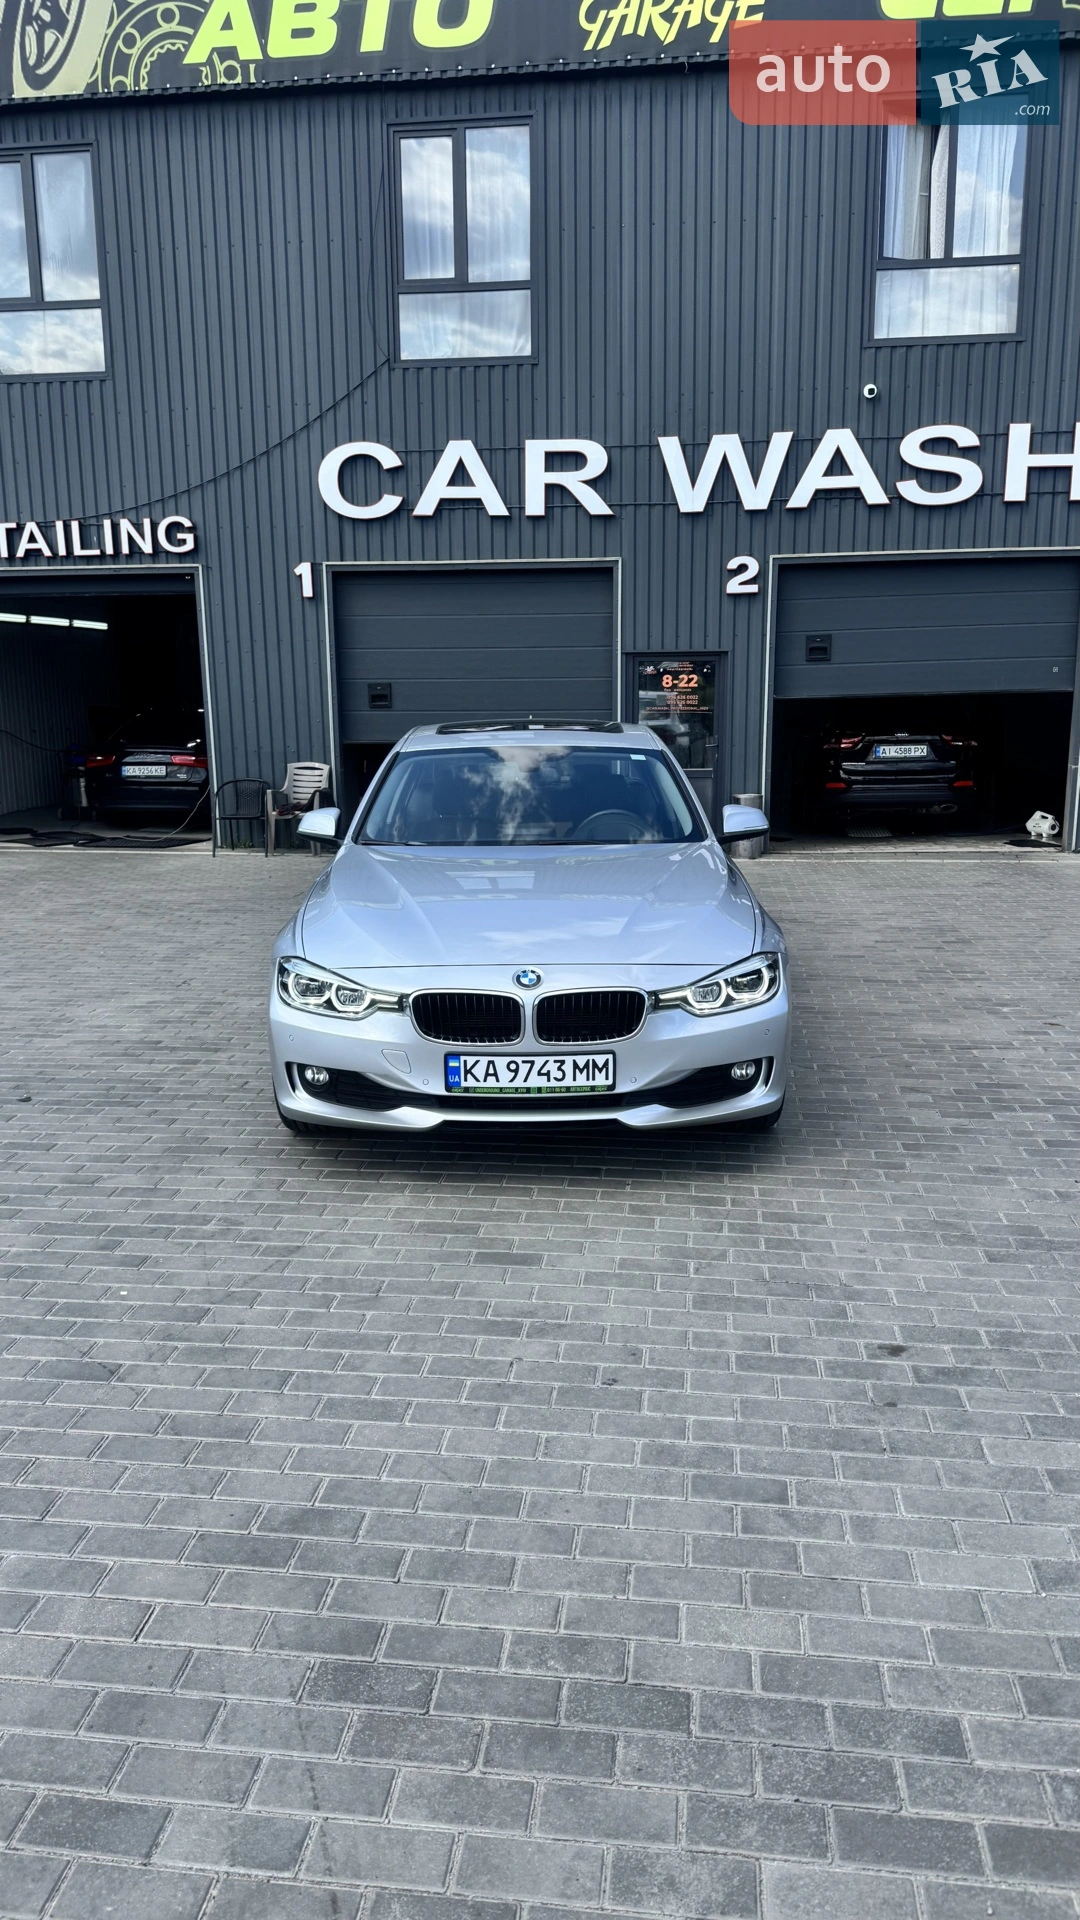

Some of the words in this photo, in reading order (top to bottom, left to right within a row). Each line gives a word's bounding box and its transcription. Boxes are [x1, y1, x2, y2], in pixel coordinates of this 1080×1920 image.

[318, 438, 616, 520] CAR
[657, 422, 1080, 513] WASH
[0, 515, 196, 559] TAILING
[294, 562, 314, 598] 1
[726, 555, 760, 595] 2
[662, 674, 698, 688] 8-22
[894, 747, 912, 755] 4588
[913, 746, 926, 755] PX
[126, 767, 137, 775] KA
[138, 767, 154, 775] 9256
[448, 1074, 460, 1083] UA
[463, 1059, 500, 1083] KA
[506, 1059, 566, 1083] 9743
[572, 1057, 610, 1082] MM
